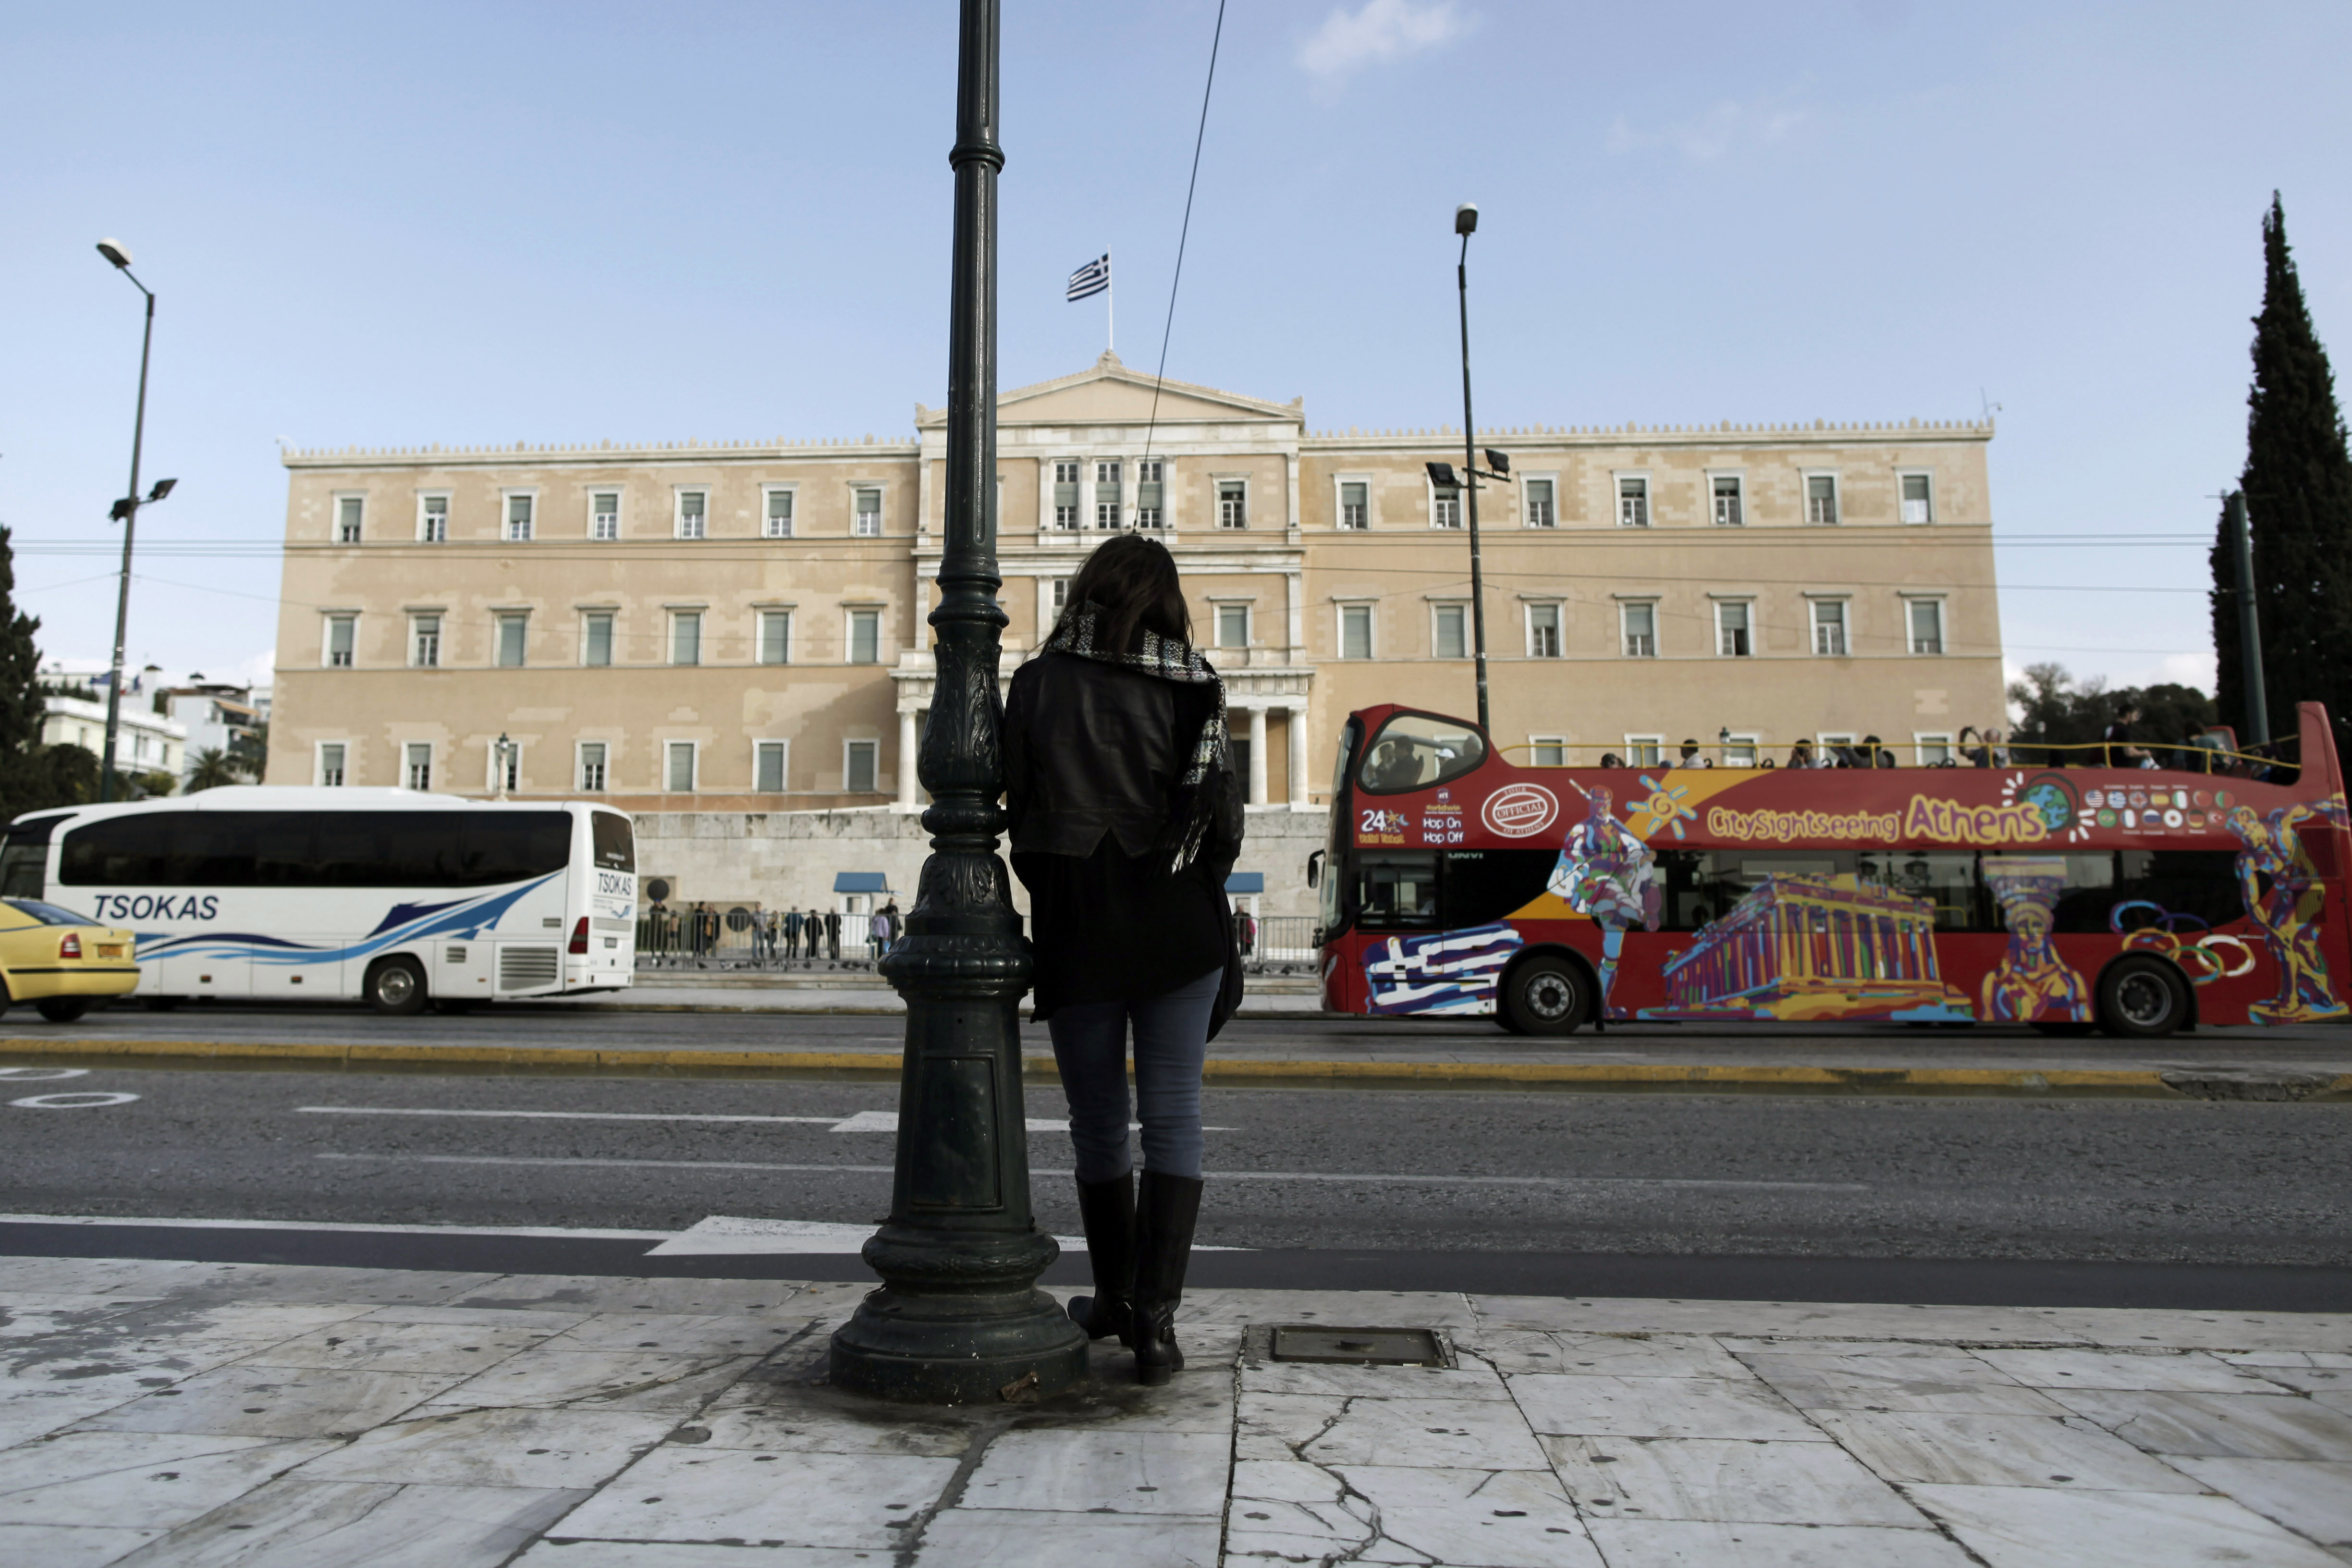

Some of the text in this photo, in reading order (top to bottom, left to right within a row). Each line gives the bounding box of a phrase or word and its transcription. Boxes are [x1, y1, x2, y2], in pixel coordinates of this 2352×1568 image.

[1360, 809, 1387, 833] 24
[1496, 802, 1544, 818] OFFICIAL
[1905, 794, 2047, 845] Athens
[1423, 817, 1462, 830] Hop On
[1423, 831, 1464, 844] Hop Off
[599, 873, 632, 896] TSOKAS
[94, 894, 219, 920] TSOKAS
